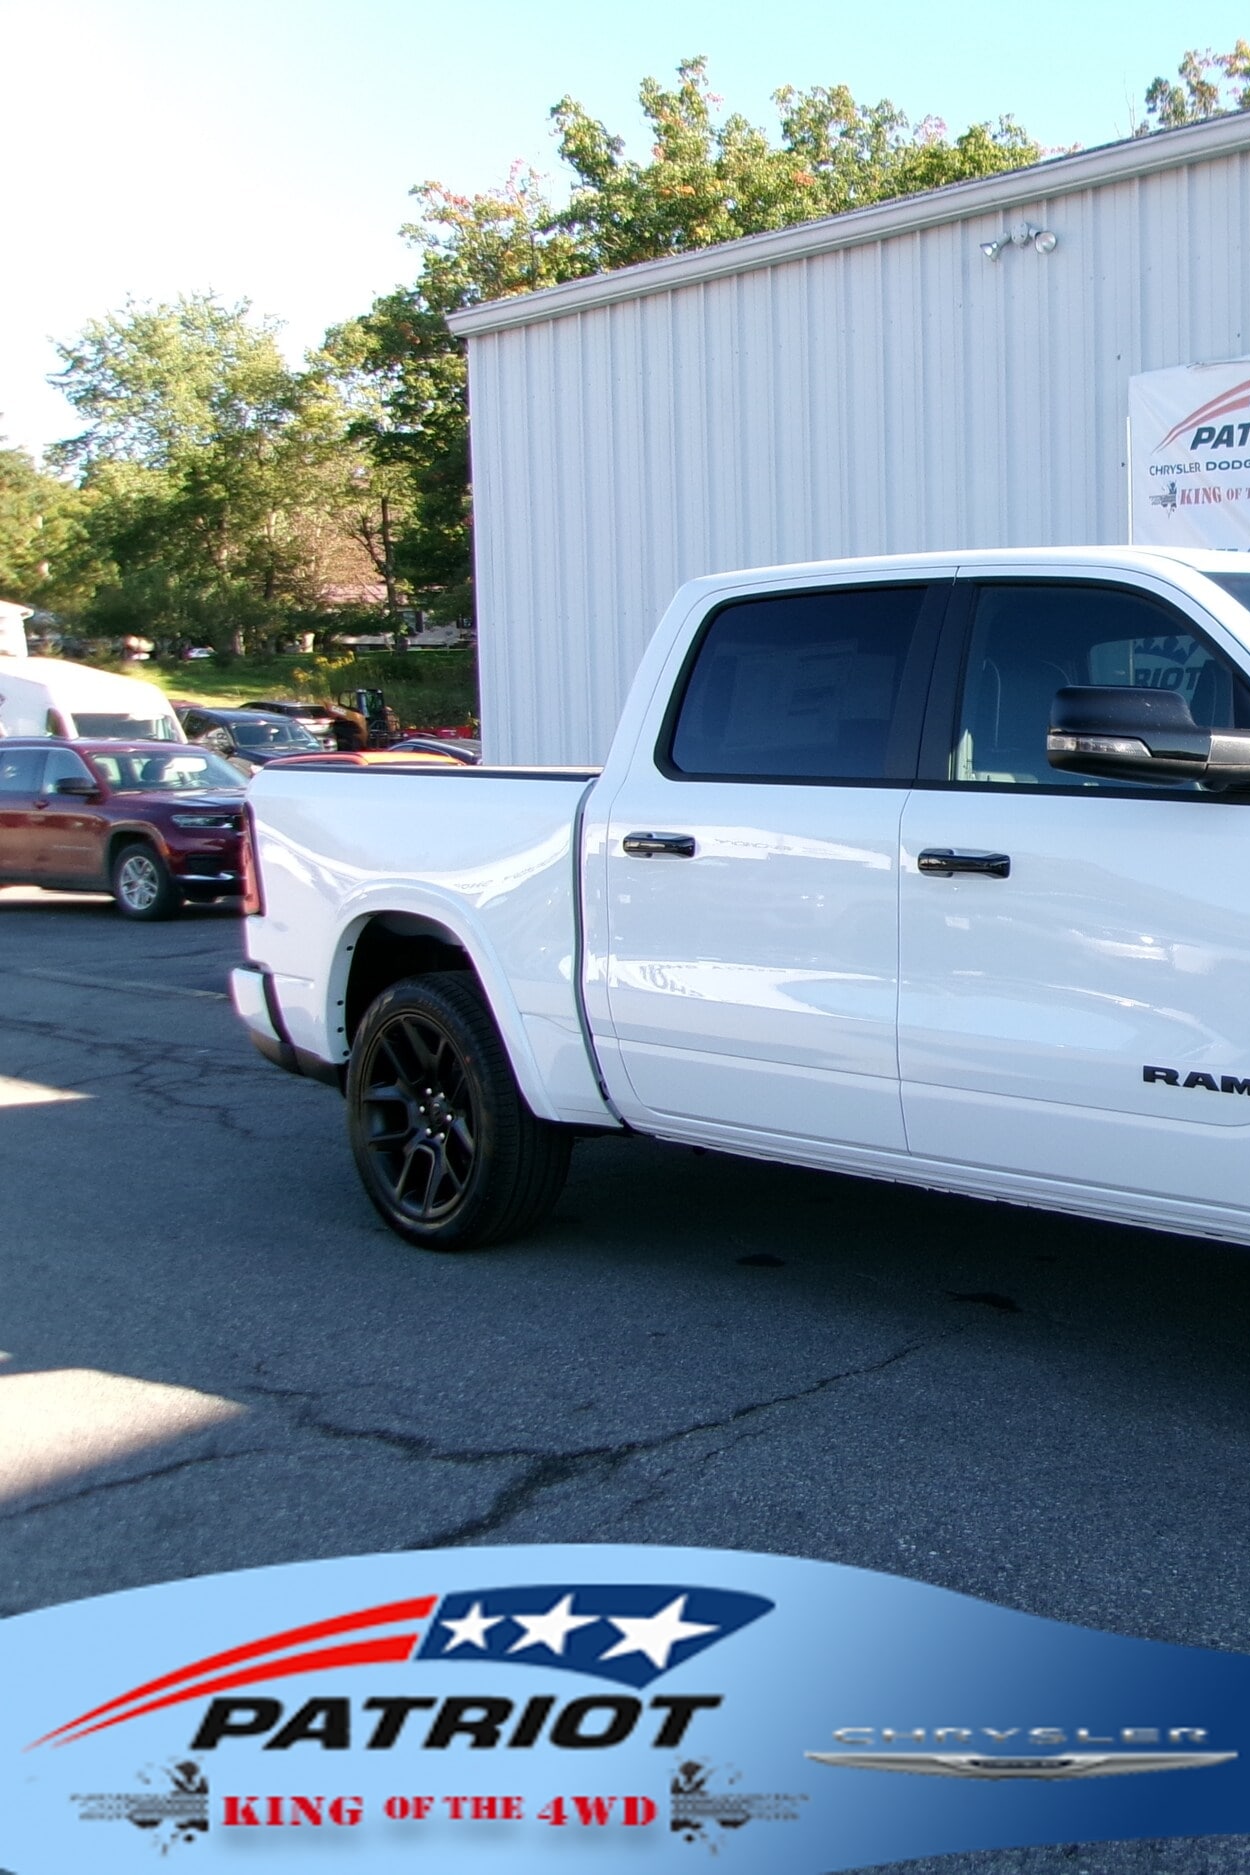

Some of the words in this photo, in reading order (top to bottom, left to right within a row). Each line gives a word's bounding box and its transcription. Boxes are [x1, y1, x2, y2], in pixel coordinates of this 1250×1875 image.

[1149, 462, 1201, 476] CHRYSLER
[1180, 486, 1222, 505] KING
[1226, 487, 1242, 501] OF
